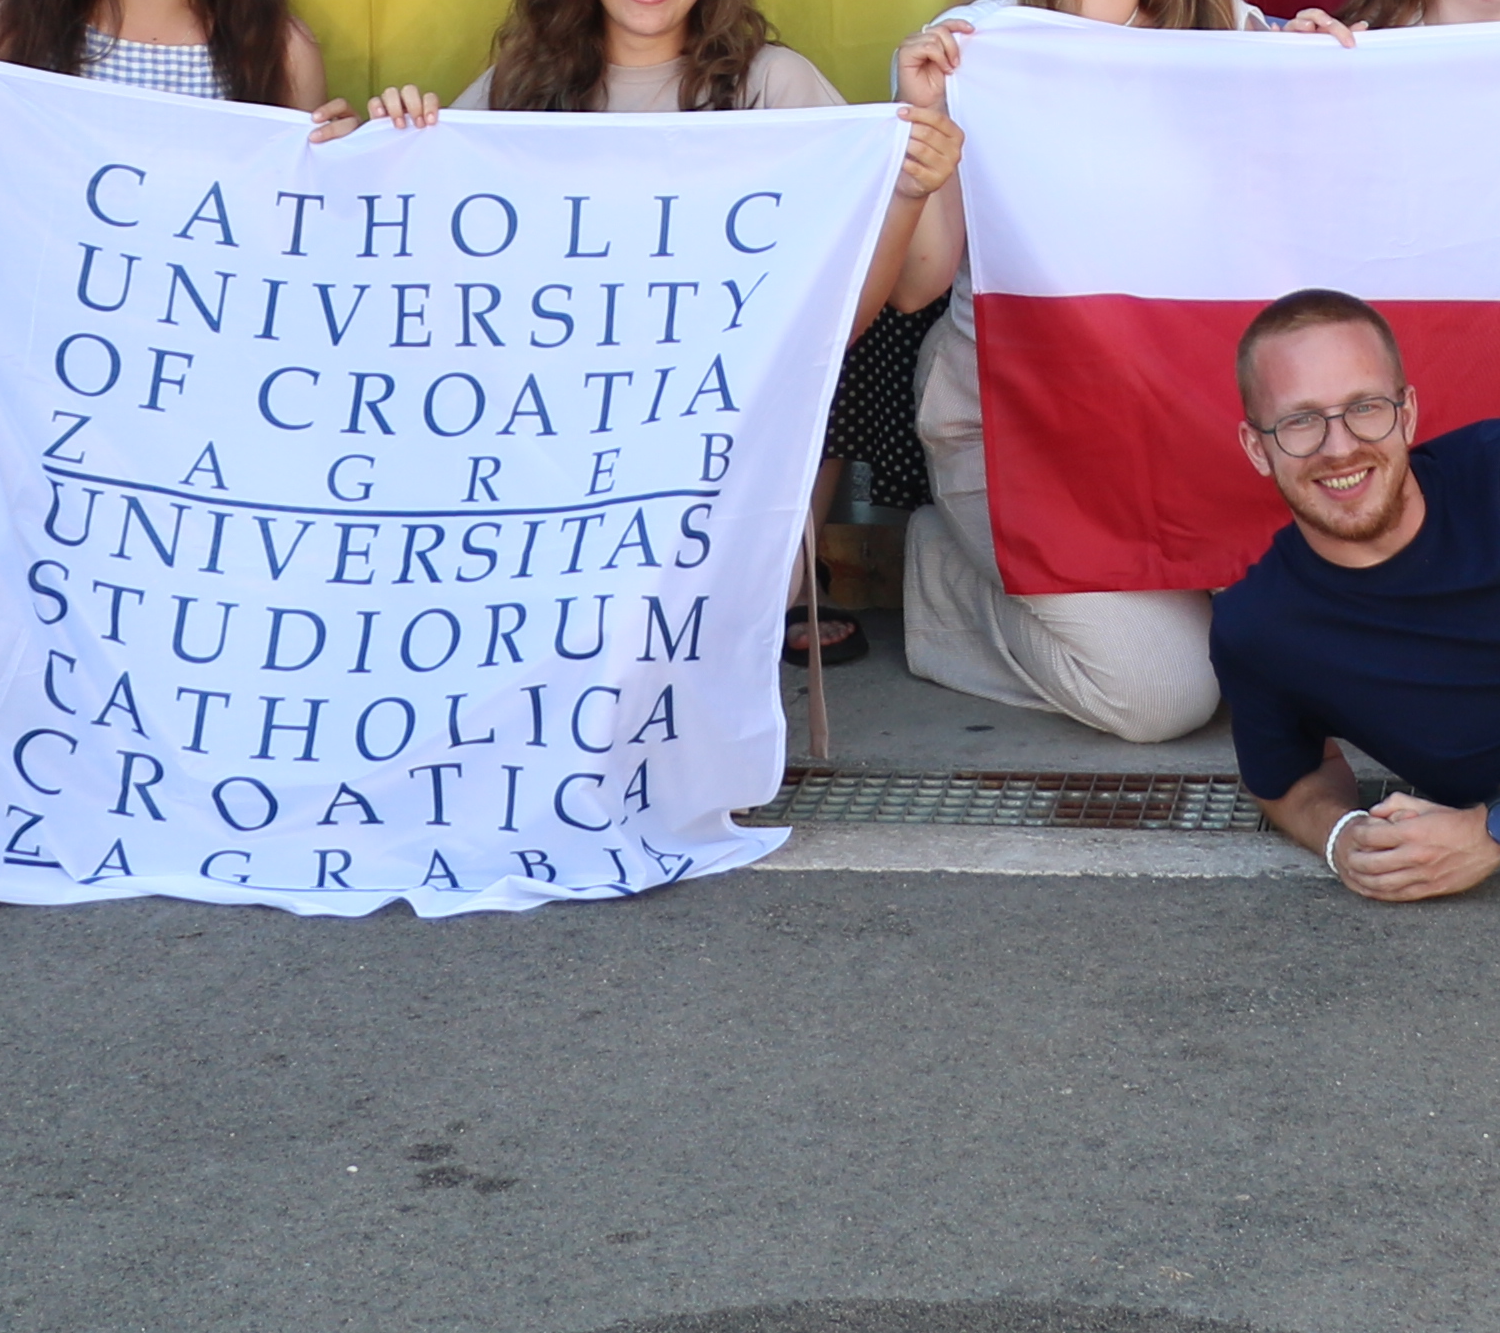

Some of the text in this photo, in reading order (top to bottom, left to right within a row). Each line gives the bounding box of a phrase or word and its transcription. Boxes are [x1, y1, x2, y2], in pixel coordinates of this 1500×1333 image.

[84, 162, 782, 259] CATHOLIC
[75, 241, 770, 348] UNIVERSITY
[54, 332, 741, 438] OF CROATIA
[43, 409, 736, 503] ZAGREB
[43, 477, 713, 586] UNIVERSITAS
[27, 559, 710, 674] STUDIORUM
[44, 649, 680, 763] CATHOLICA
[11, 728, 652, 834] CROATICA
[3, 803, 686, 890] ZAGRABIA
